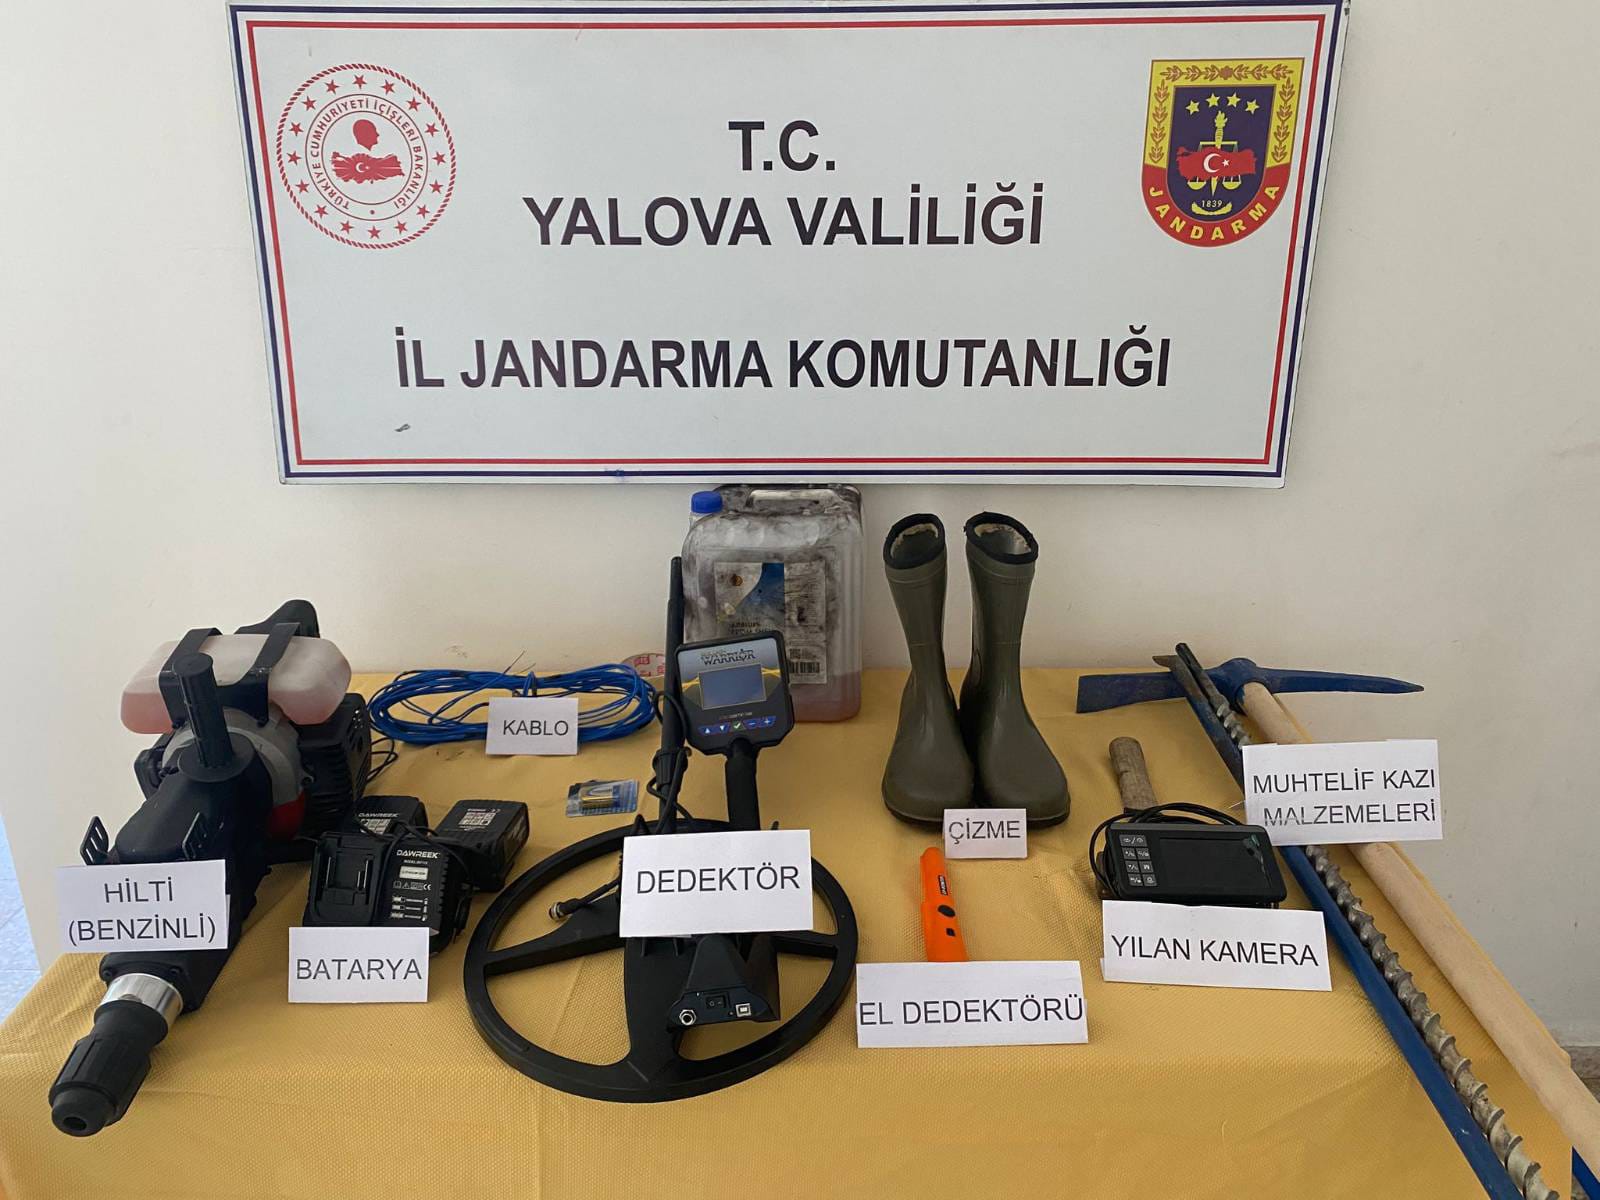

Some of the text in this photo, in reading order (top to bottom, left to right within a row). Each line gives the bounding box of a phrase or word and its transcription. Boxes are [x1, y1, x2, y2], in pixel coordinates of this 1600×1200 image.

[310, 98, 423, 210] TÜRKİYE CUMHURİYETİ İÇİŞLERİ BAKANLIĞI
[729, 120, 836, 172] T.C.
[522, 181, 1044, 247] YALOVA VALİLİĞİ
[1149, 185, 1280, 241] JANDARMA
[1201, 199, 1223, 208] 1839
[395, 324, 1170, 389] İL JANDARMA KOMUTANLIĞI
[503, 719, 570, 737] KABLO
[1253, 768, 1436, 794] MUHTELİF KAZI
[1262, 798, 1437, 827] MALZEMELERİ
[948, 818, 1021, 845] ÇİZME
[396, 849, 439, 859] DAWREEK
[103, 876, 174, 904] HİLTİ
[636, 861, 801, 895] DEDEKTÖR
[68, 914, 217, 947] (BENZİNLİ)
[1111, 934, 1319, 967] YILAN KAMERA
[296, 957, 421, 982] BATARYA
[859, 994, 1084, 1026] EL DEDEKTÖRÜ
